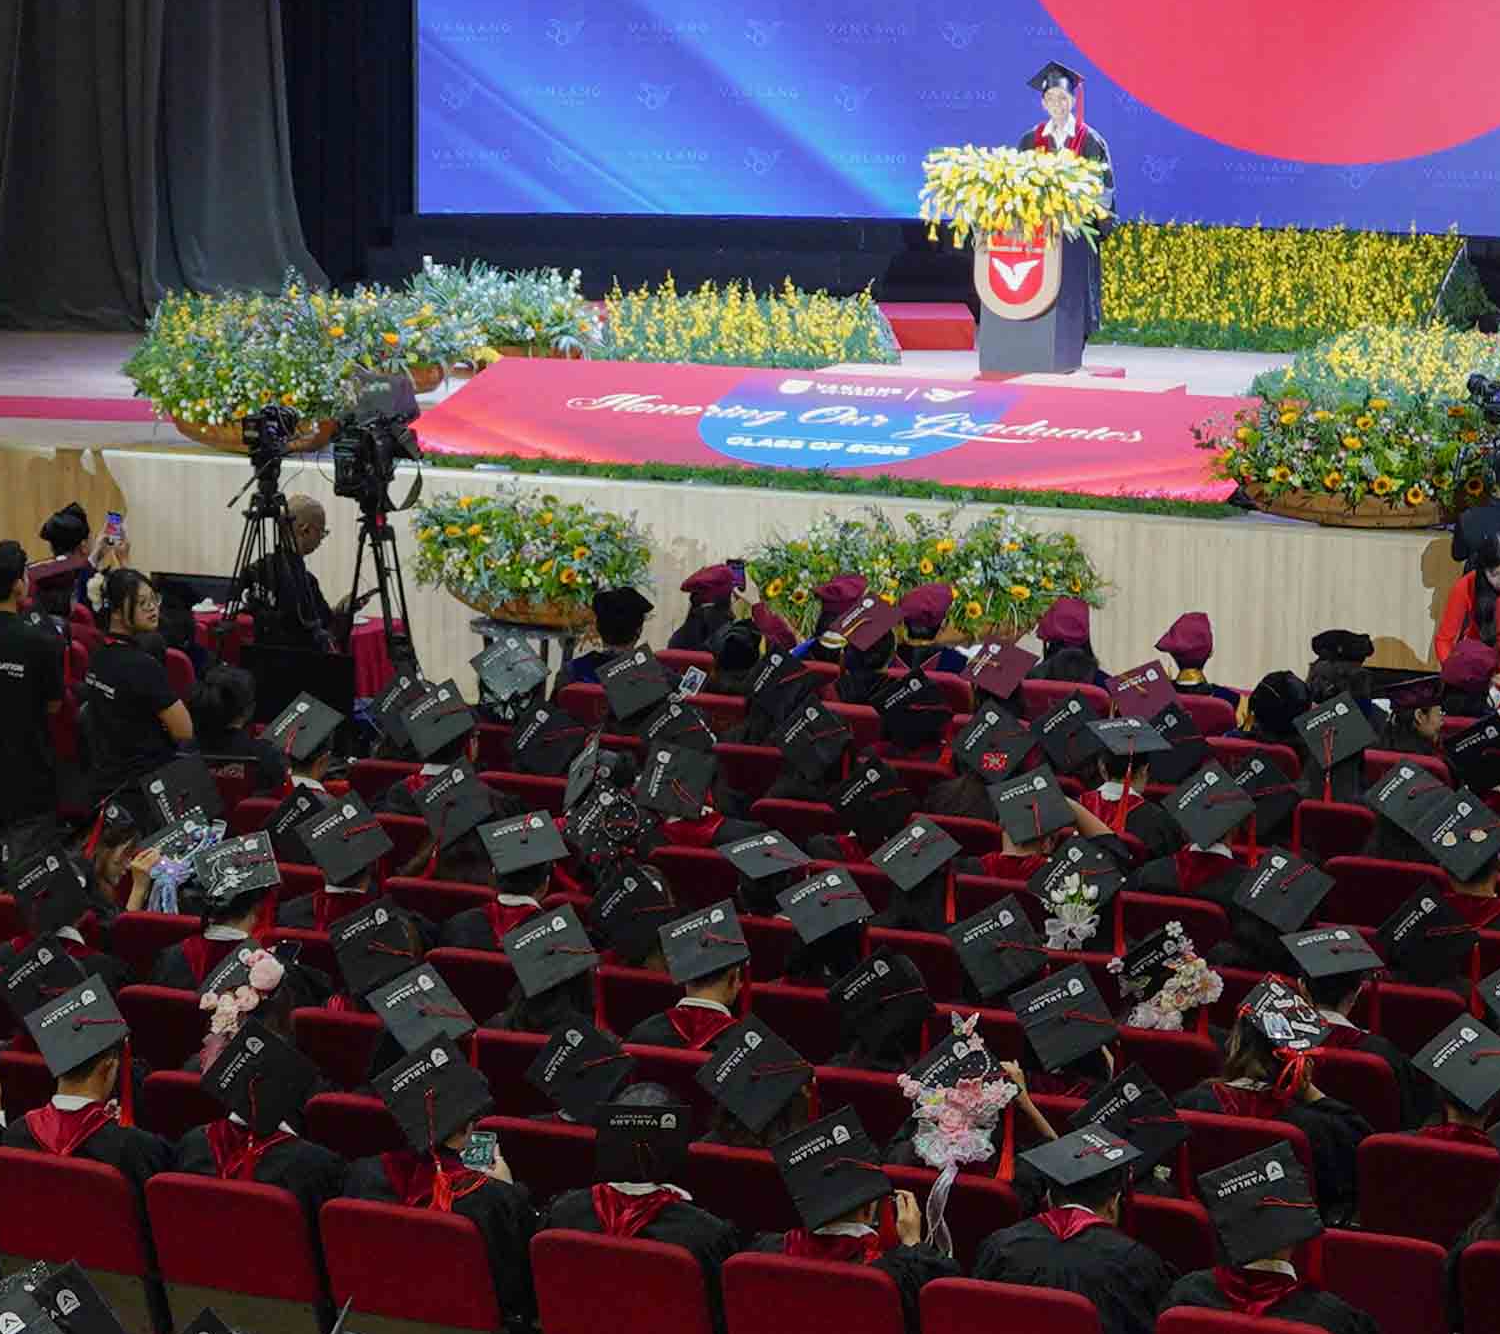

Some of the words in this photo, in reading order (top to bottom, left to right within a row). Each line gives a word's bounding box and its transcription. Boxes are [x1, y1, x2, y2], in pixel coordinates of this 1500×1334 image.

[567, 393, 785, 426] Honoring
[798, 406, 888, 428] Our
[892, 410, 1143, 443] Graduates
[726, 437, 802, 449] CLASS
[809, 441, 842, 451] OF
[513, 928, 552, 949] VANLANG
[670, 919, 711, 937] VANLANG
[1028, 993, 1066, 1012] VANLANG
[40, 1002, 81, 1027] VANLANG
[392, 1058, 432, 1091] VANLANG
[716, 1047, 746, 1083] VANLANG
[610, 1118, 657, 1127] VANLANG
[789, 1143, 832, 1164] VANLANG
[1216, 1175, 1265, 1197] VANLANG
